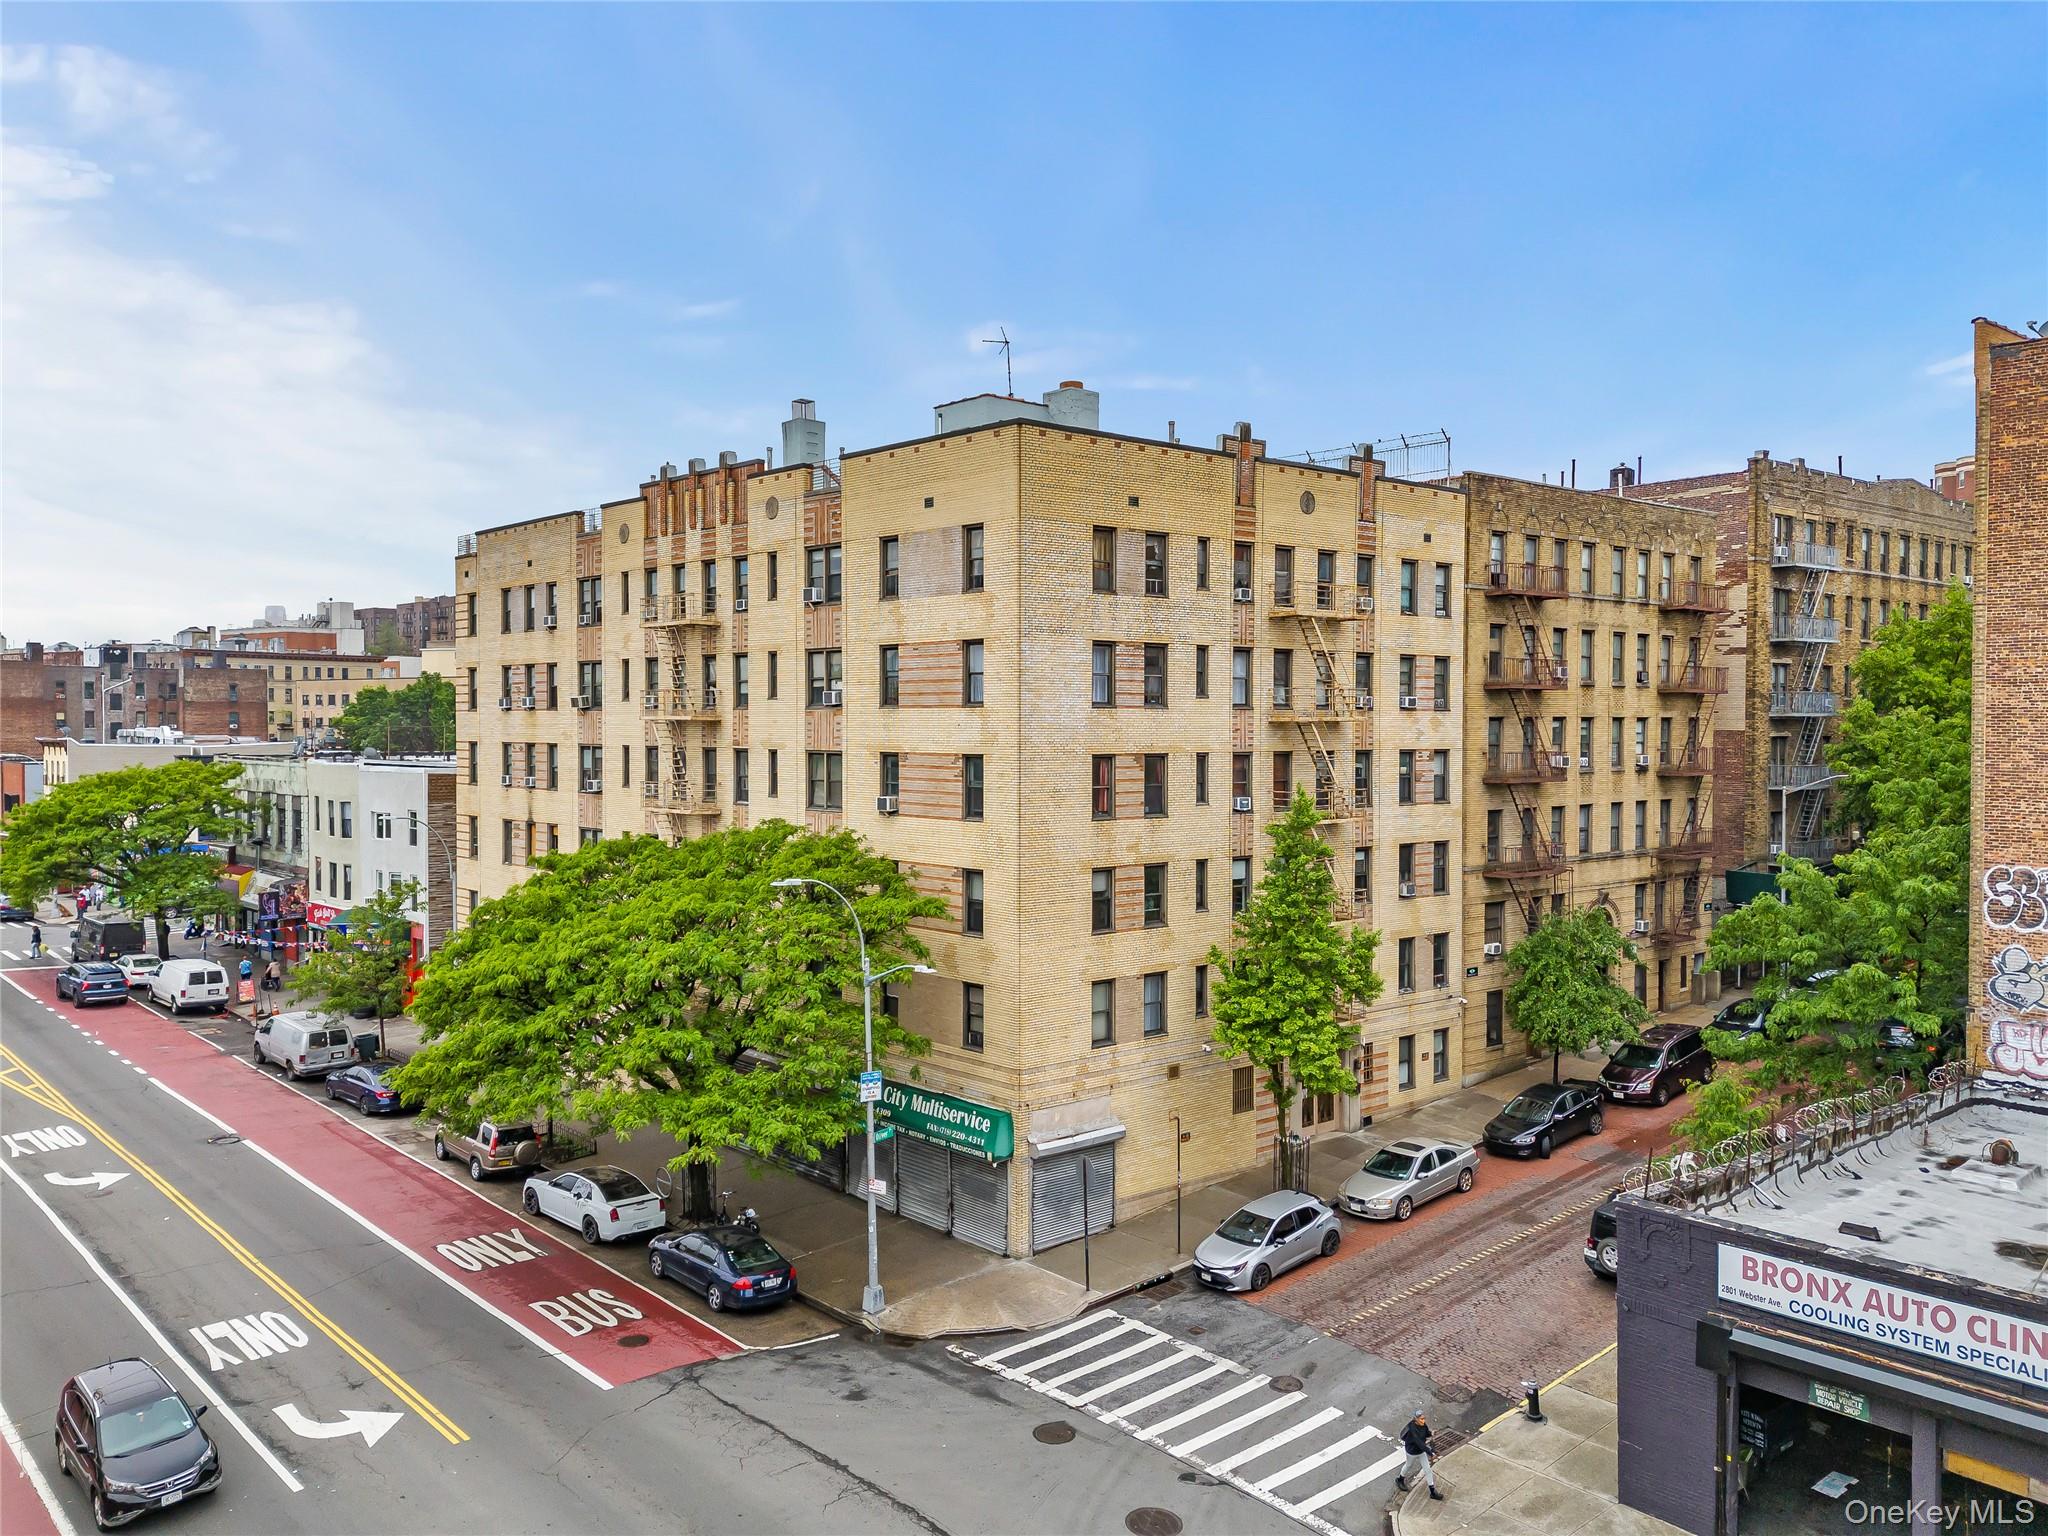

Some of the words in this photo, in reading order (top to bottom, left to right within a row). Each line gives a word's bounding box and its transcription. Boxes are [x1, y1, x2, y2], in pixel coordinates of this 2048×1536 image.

[883, 1086, 909, 1111] City
[910, 1094, 991, 1133] Multiservice
[1, 1125, 88, 1158] ONLY
[949, 1141, 986, 1159] TRADUCCIONES
[951, 1130, 985, 1146] 220-4311
[435, 1228, 549, 1272] ONLY
[528, 1288, 644, 1338] BUS
[1721, 1284, 1737, 1296] 2801
[1738, 1288, 1767, 1304] Webster
[1767, 1297, 1783, 1309] Ave.
[1742, 1254, 1853, 1309] BRONX
[1862, 1287, 1957, 1334] AUTO
[1967, 1315, 2048, 1361] CLIN
[188, 1311, 309, 1372] ONLY
[1789, 1299, 1870, 1333] COOLING
[1875, 1323, 1950, 1356] SYSTEM
[1956, 1345, 2048, 1383] SPECIALI
[1815, 1388, 1837, 1402] MOTOR
[1838, 1396, 1863, 1410] VEHICLE
[1817, 1396, 1841, 1410] REPAIR
[1843, 1405, 1861, 1416] SHOP
